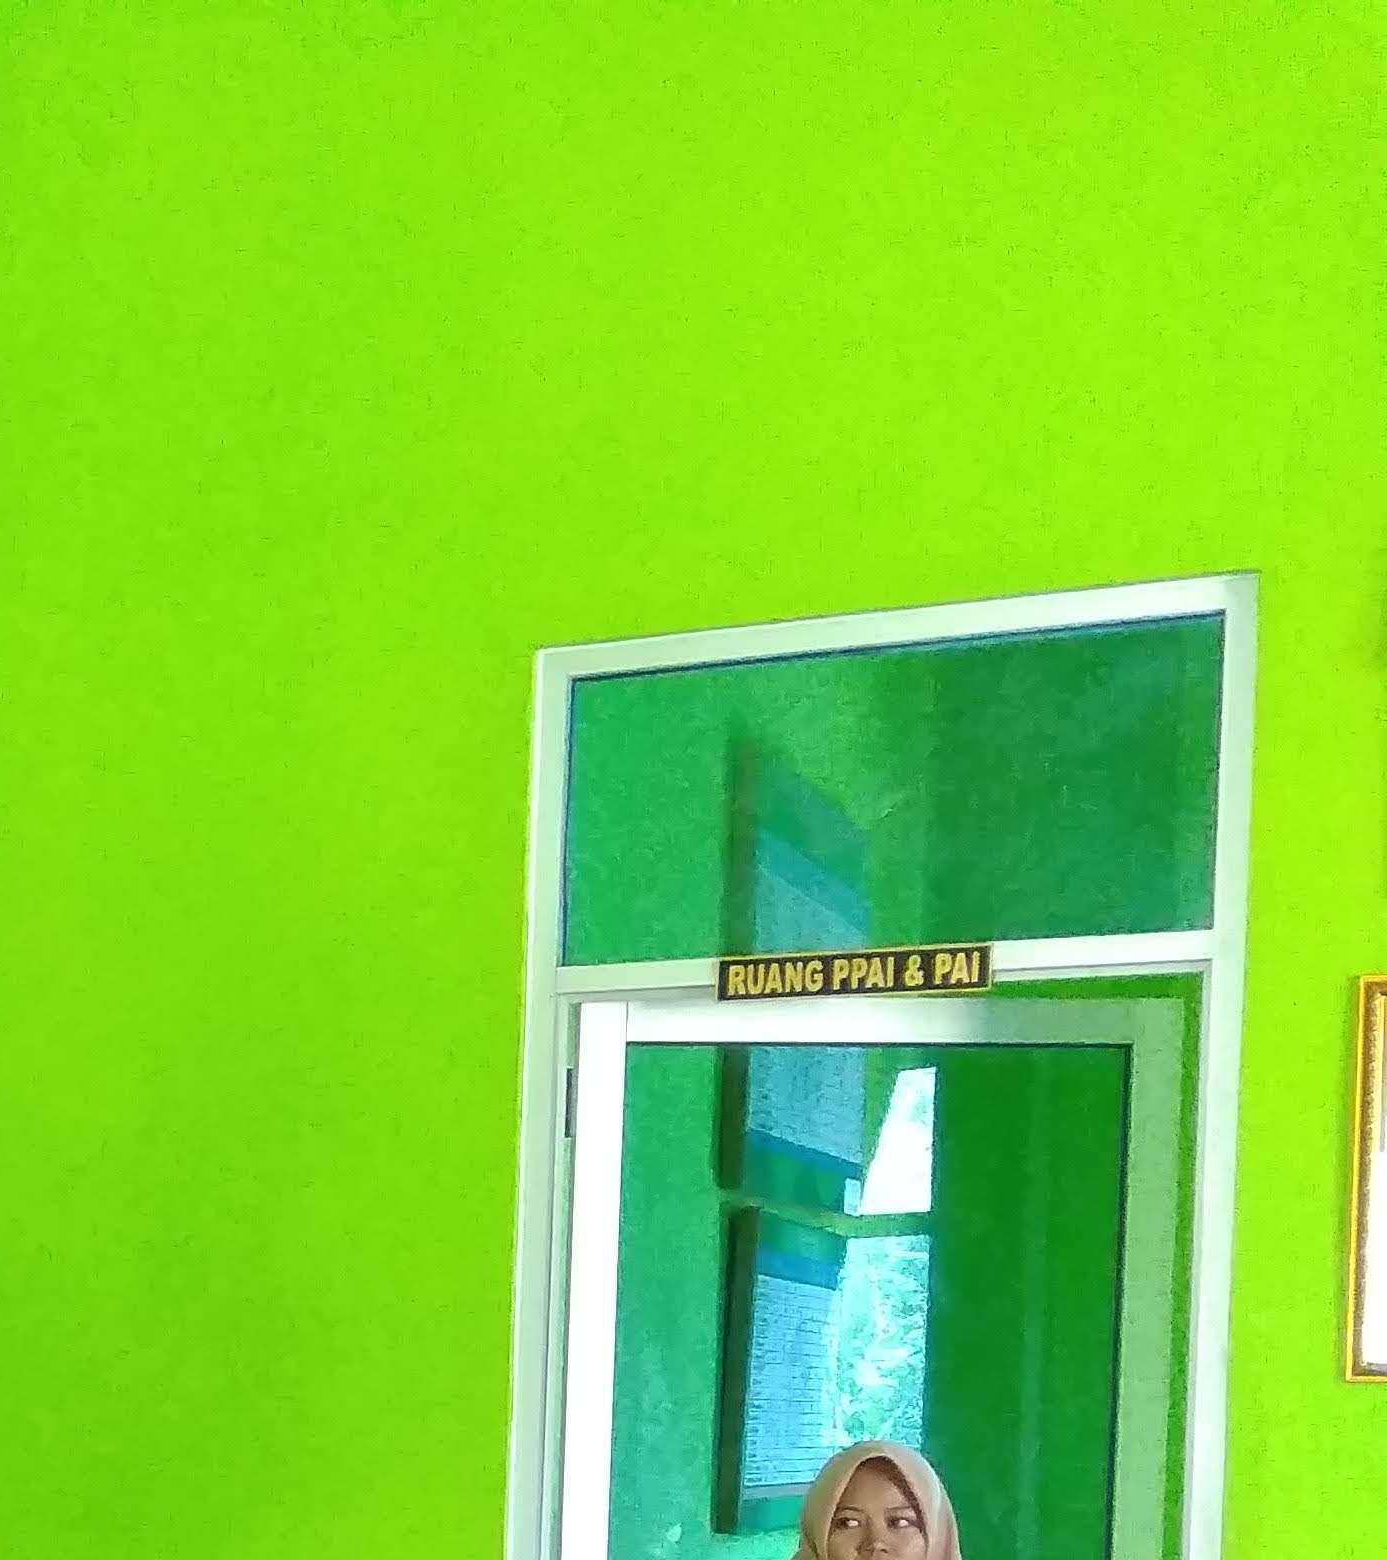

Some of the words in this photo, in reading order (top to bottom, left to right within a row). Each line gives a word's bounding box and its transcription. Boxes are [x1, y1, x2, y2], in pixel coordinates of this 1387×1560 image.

[727, 960, 824, 996] RUANG
[832, 956, 894, 991] PPAI
[904, 955, 924, 986] &
[934, 951, 981, 985] PAI
